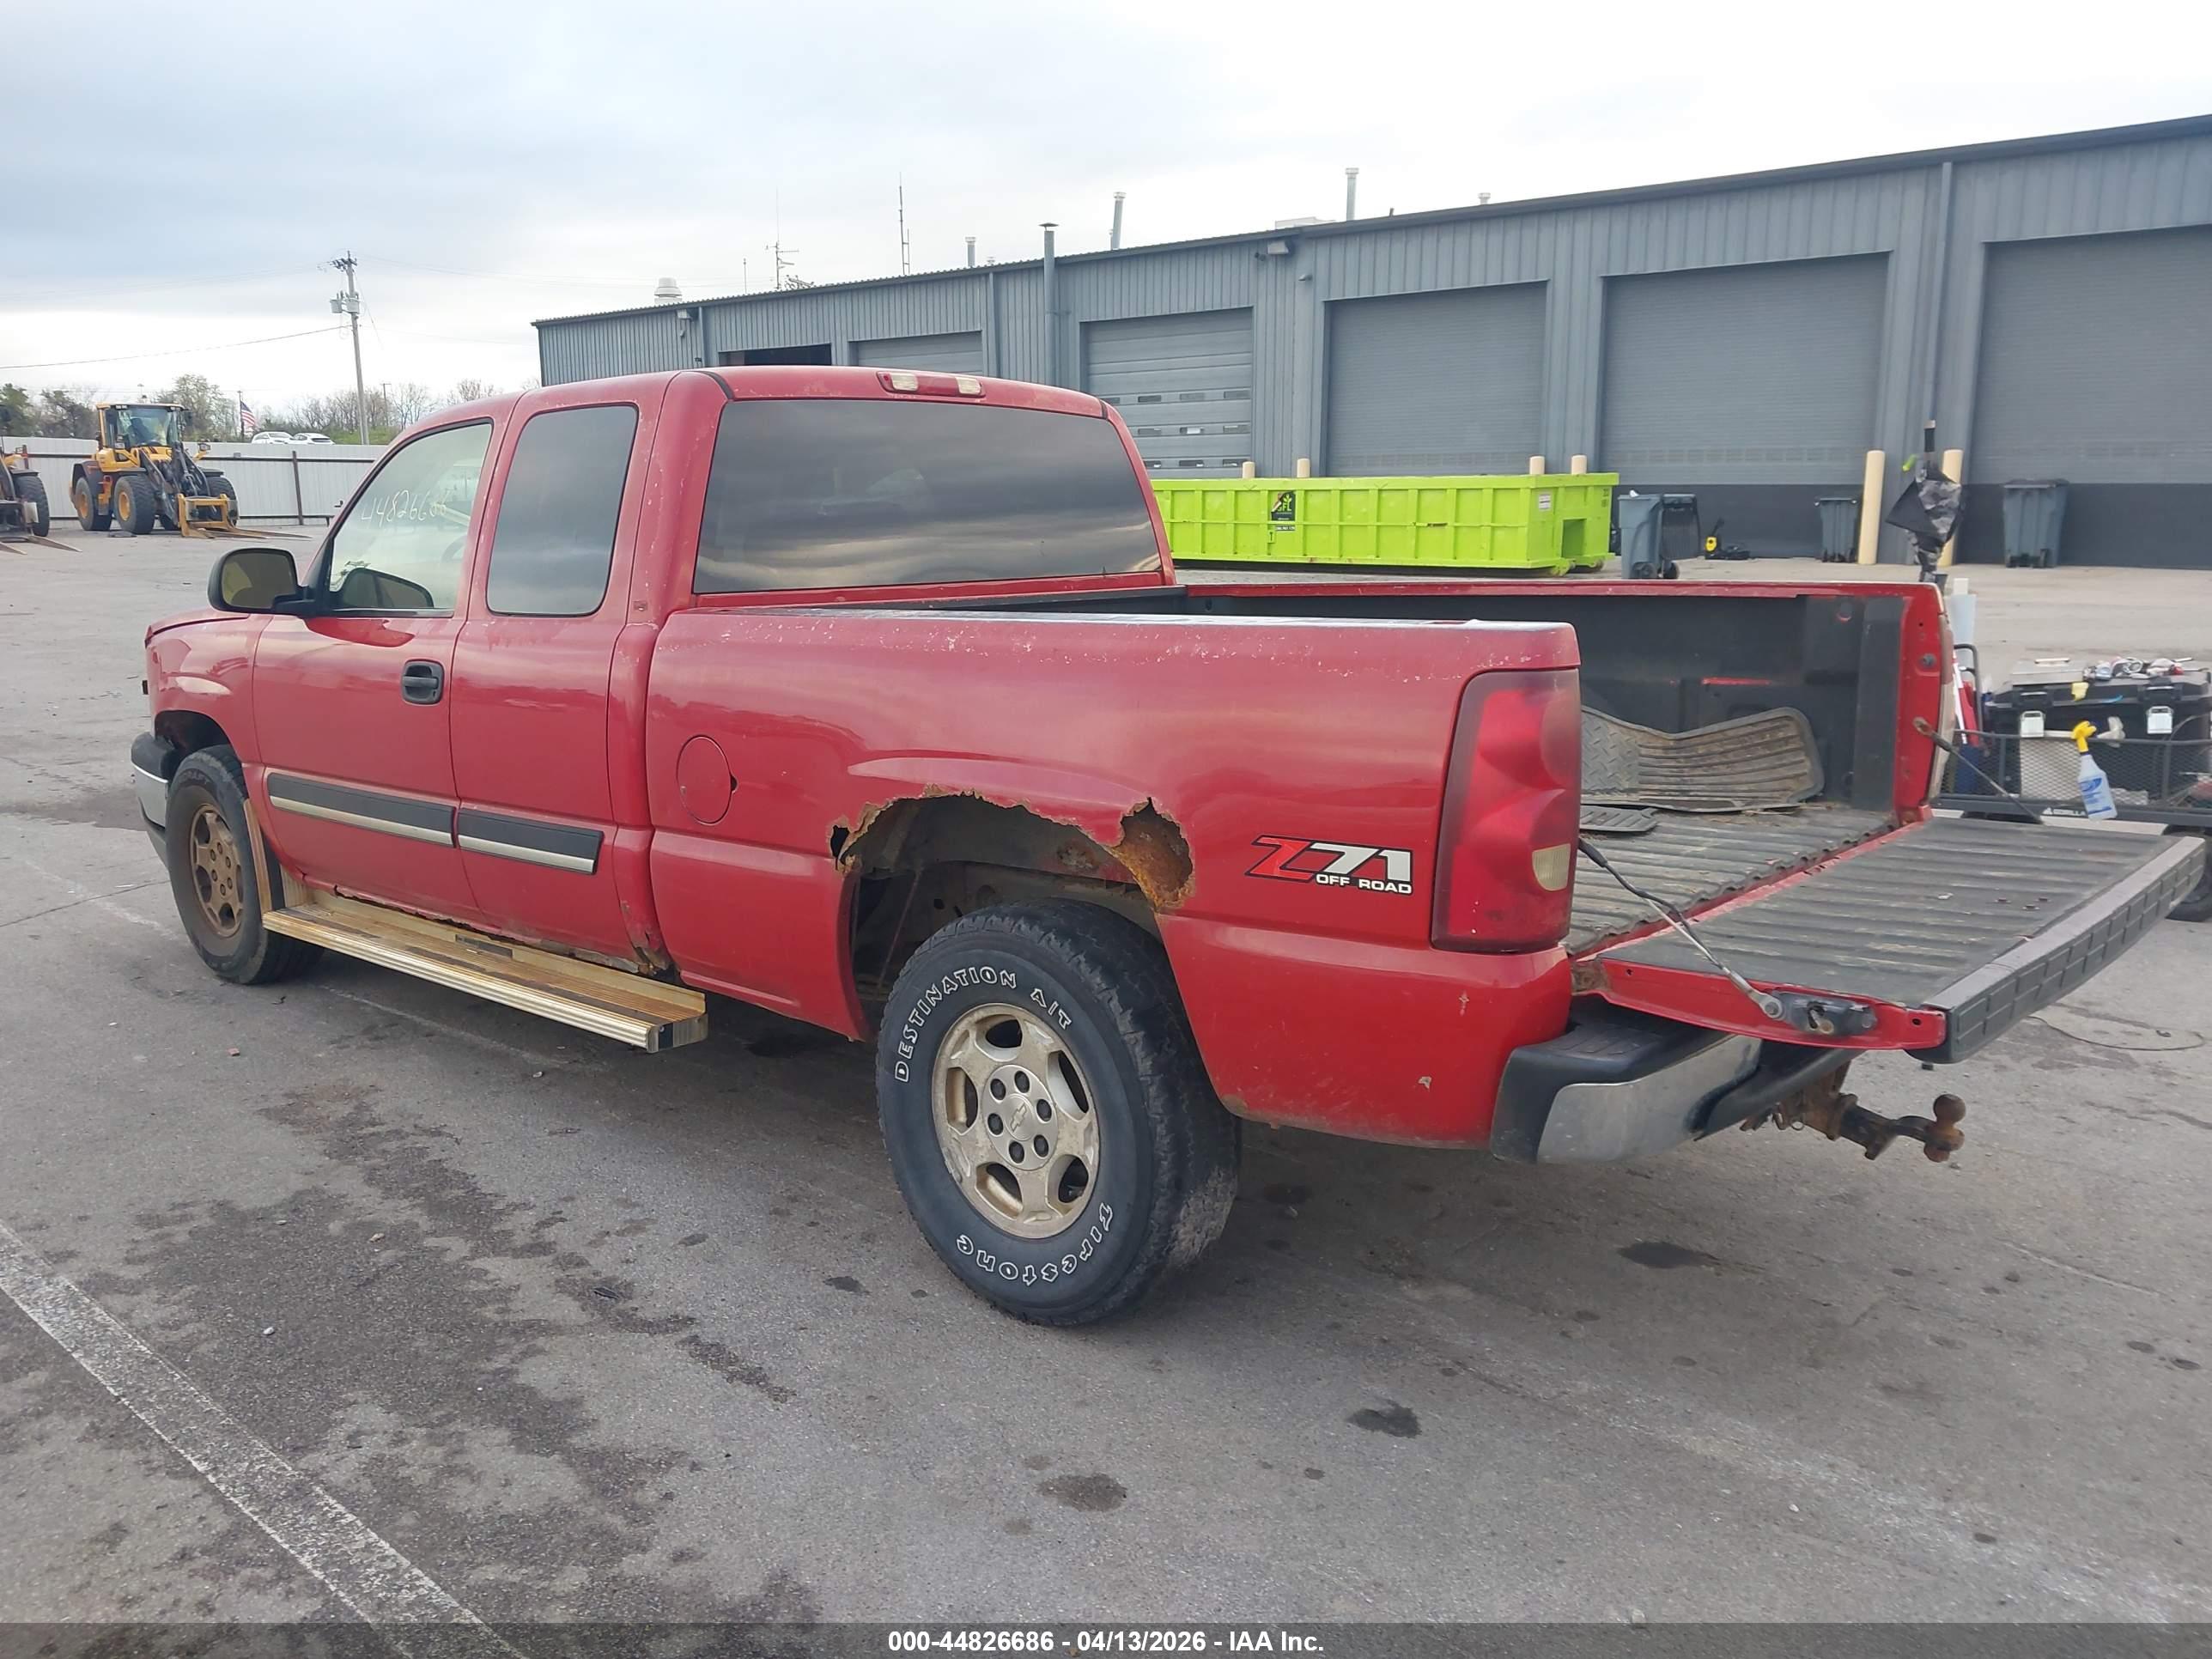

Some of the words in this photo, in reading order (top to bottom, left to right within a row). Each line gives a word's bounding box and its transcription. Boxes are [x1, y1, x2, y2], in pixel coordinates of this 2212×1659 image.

[1244, 835, 1413, 884] Z71
[1316, 874, 1351, 886] OFF
[1358, 878, 1413, 895] ROAD
[895, 966, 1018, 1082] DESTINATION
